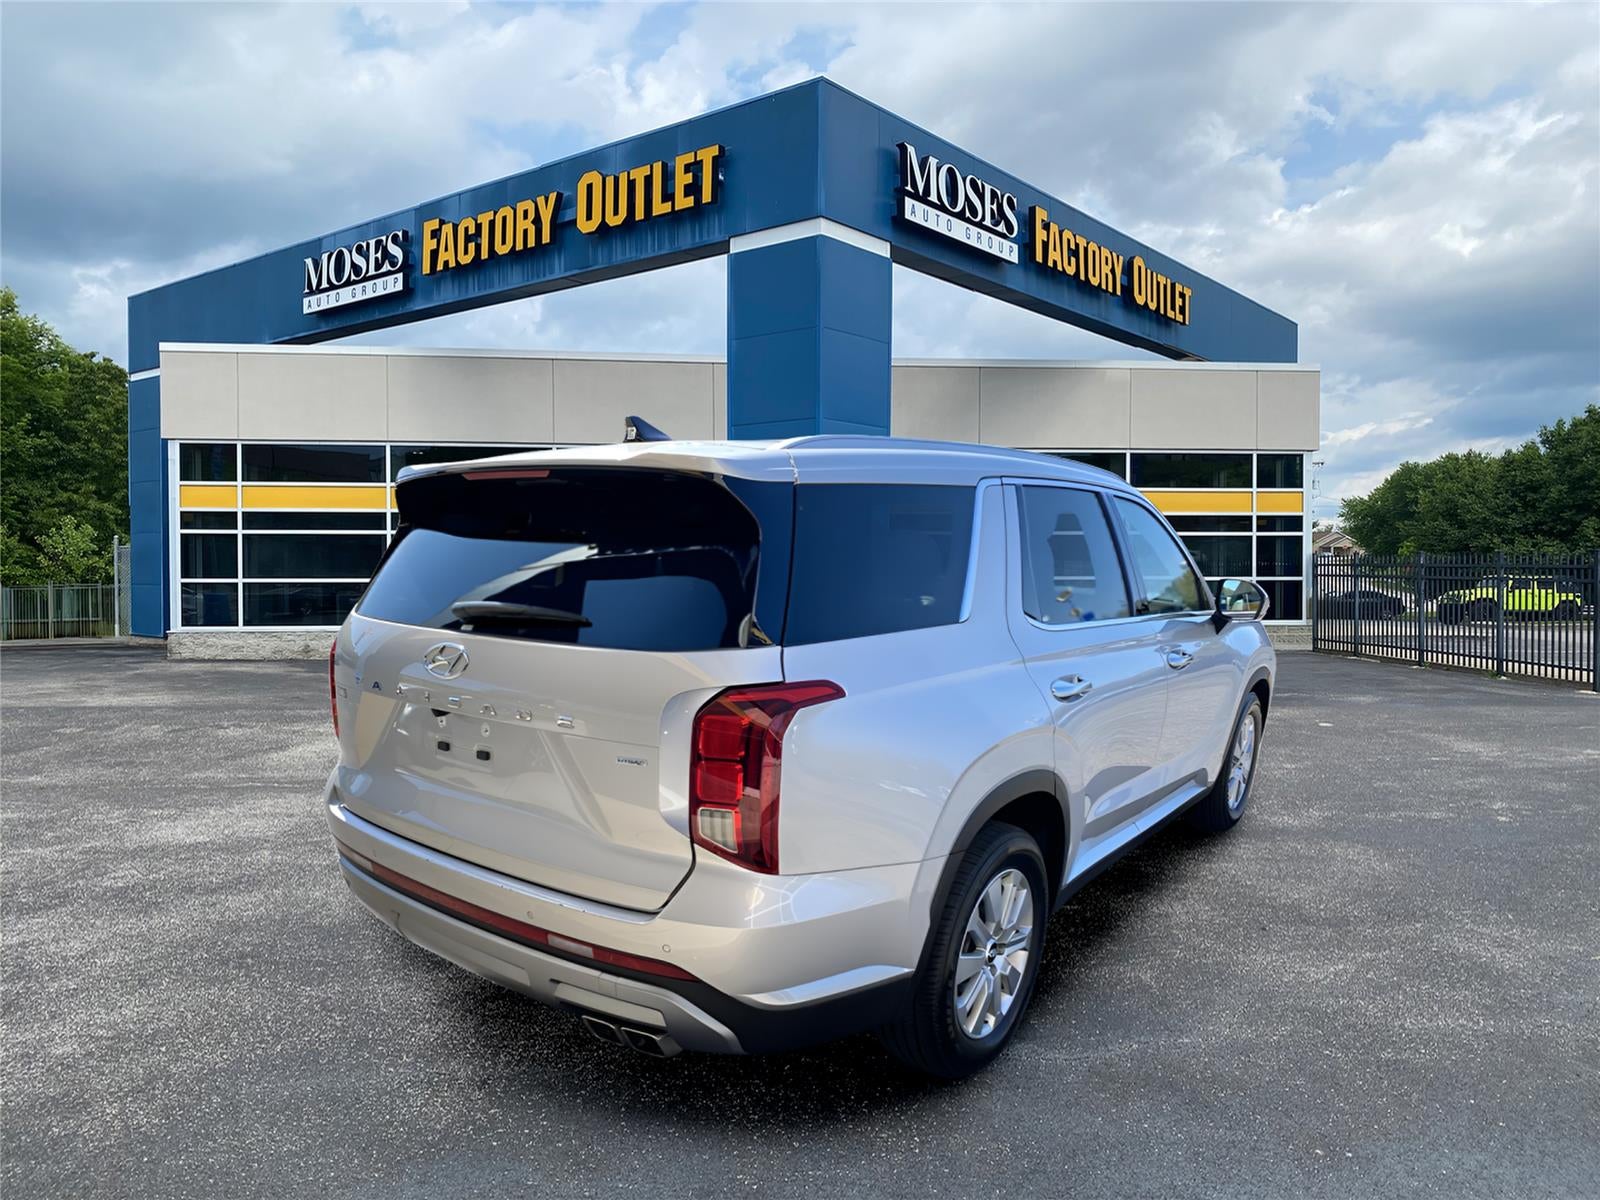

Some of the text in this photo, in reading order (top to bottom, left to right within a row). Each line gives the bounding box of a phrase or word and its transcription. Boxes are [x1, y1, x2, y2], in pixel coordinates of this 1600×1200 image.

[422, 144, 720, 275] FACTORY OUTLET
[904, 142, 1018, 238] MOSES
[303, 230, 404, 292] MOSES
[910, 203, 1015, 257] AUTO GROUP
[1034, 205, 1192, 325] FACTORY OUTLET
[307, 277, 400, 309] AUTO GROUP
